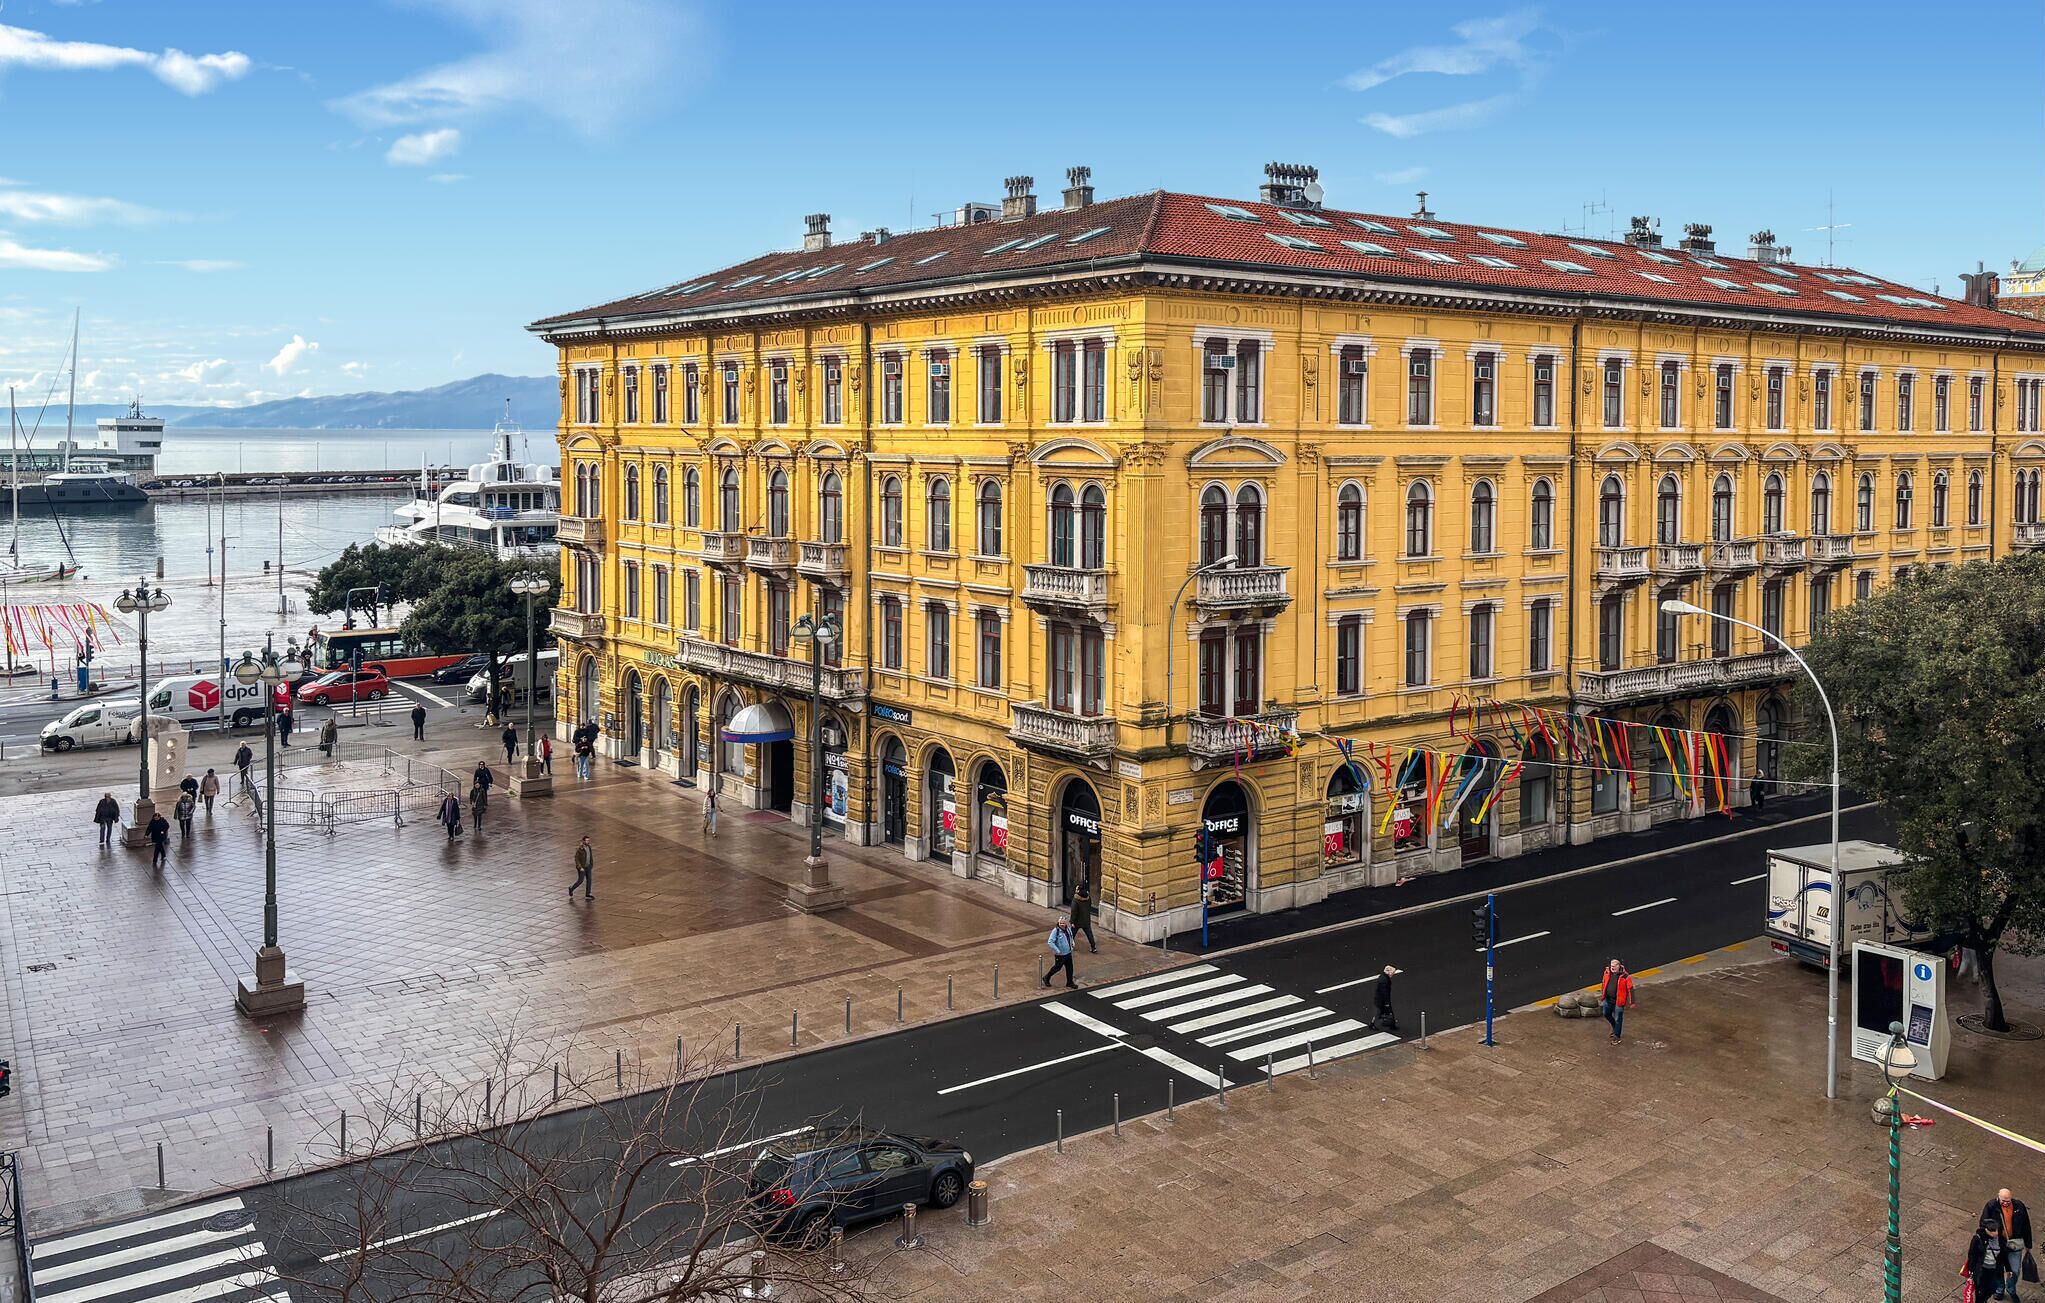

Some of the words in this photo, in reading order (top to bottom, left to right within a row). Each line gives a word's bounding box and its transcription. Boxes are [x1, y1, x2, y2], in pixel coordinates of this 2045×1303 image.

[225, 683, 259, 701] dpd
[1070, 814, 1097, 829] OFFICE
[1208, 818, 1238, 831] OFFICE
[1393, 822, 1405, 837] %
[1325, 835, 1338, 851] %
